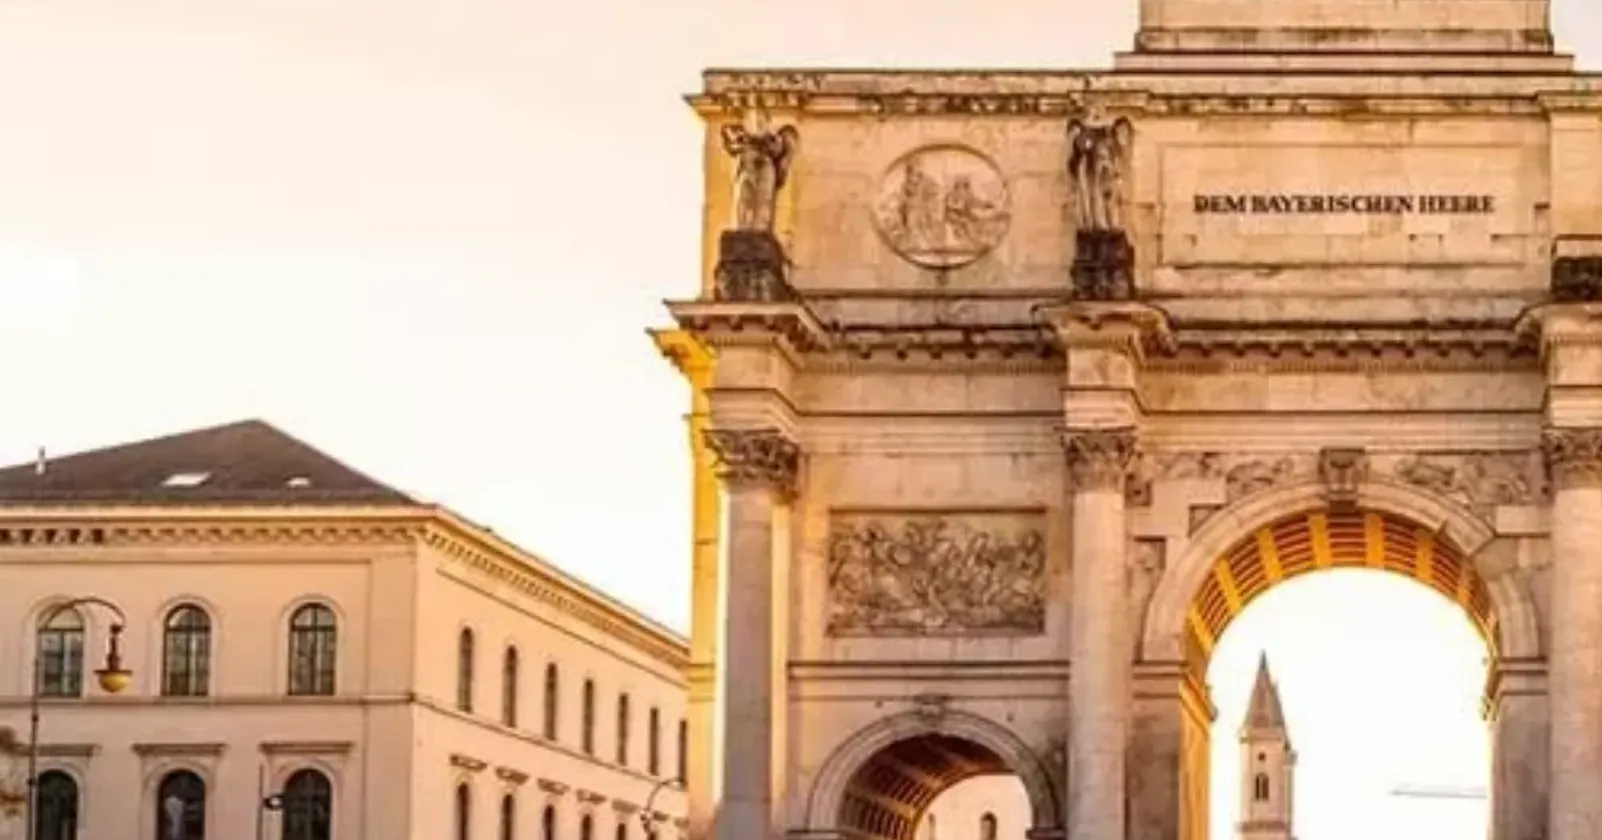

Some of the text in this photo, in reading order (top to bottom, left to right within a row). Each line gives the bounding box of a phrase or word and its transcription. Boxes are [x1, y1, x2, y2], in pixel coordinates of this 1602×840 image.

[1193, 195, 1494, 215] DEM BAYERISCHEN HEERE
